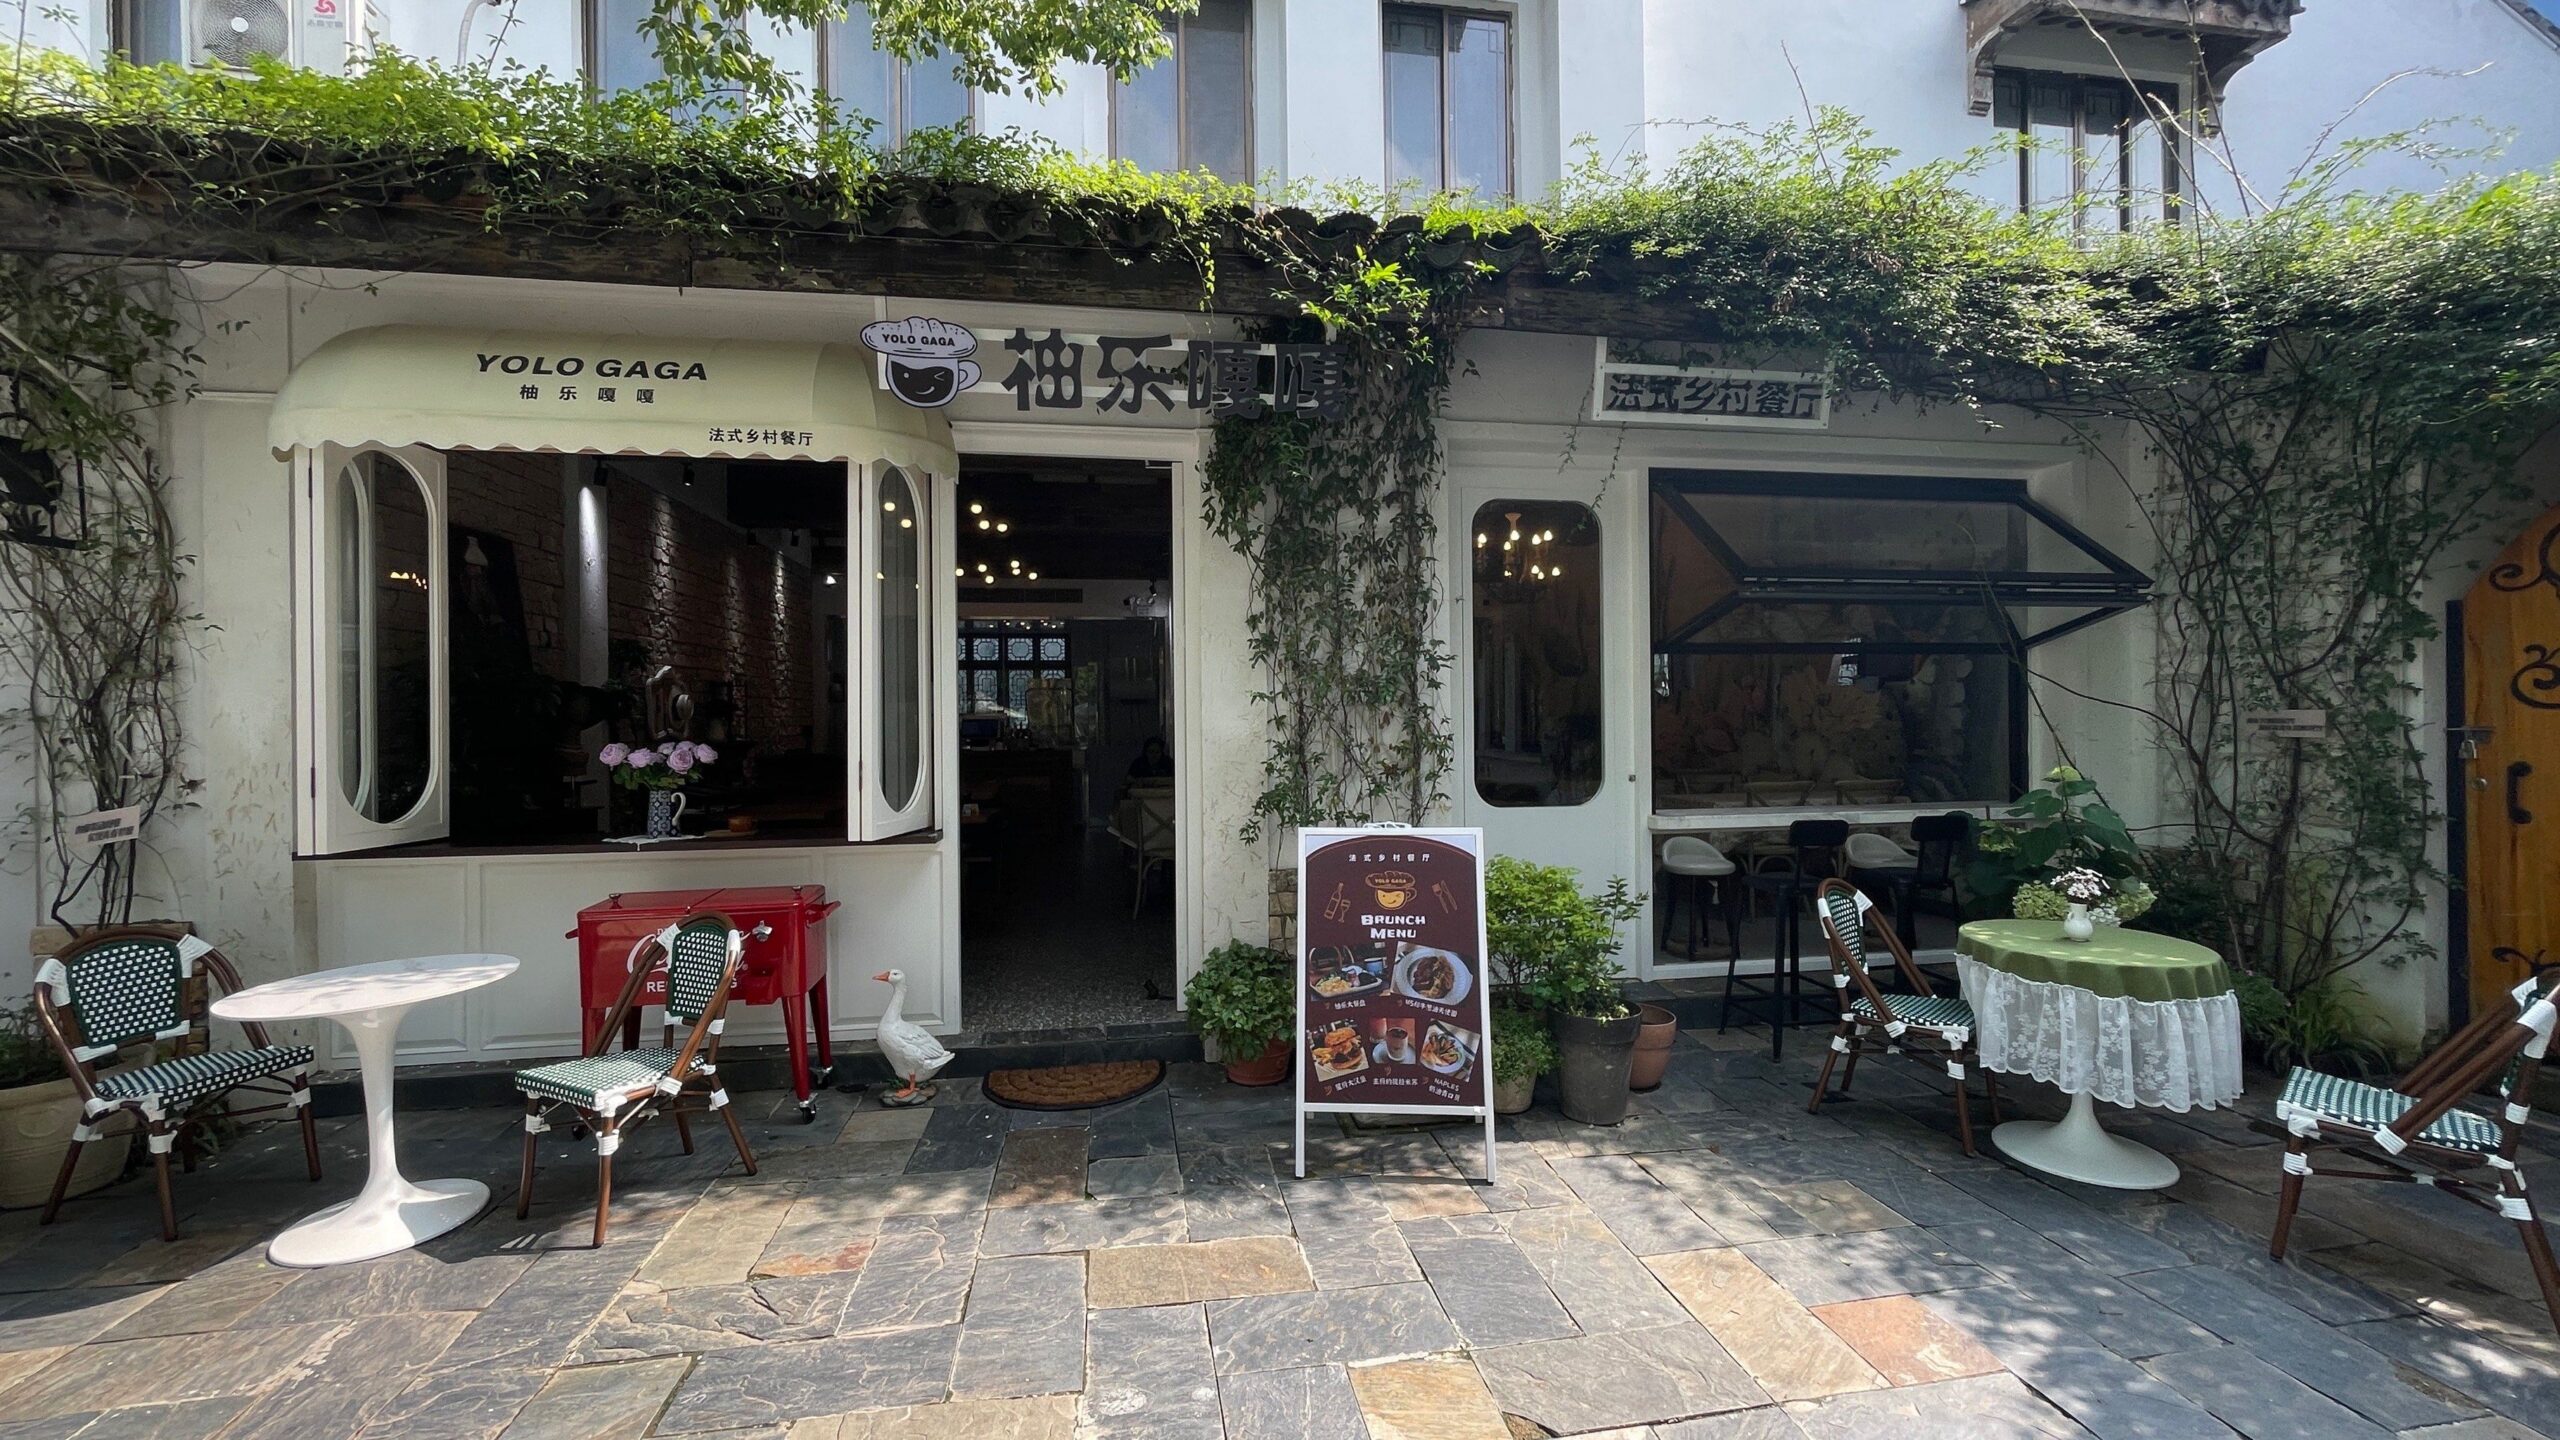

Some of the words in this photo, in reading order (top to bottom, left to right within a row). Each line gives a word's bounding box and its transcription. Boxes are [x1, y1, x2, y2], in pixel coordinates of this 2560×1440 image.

[881, 333, 916, 345] YOLO
[920, 335, 956, 347] GAGA
[476, 353, 585, 376] YOLO
[595, 358, 708, 381] GAGA
[1002, 327, 1349, 419] 柚乐嘎嘎
[520, 384, 655, 404] 柚乐嘎嘎
[1607, 374, 1823, 417] 法式乡村餐厅
[709, 427, 814, 446] 法式乡村餐厅
[1349, 853, 1430, 862] 法式乡村餐厅
